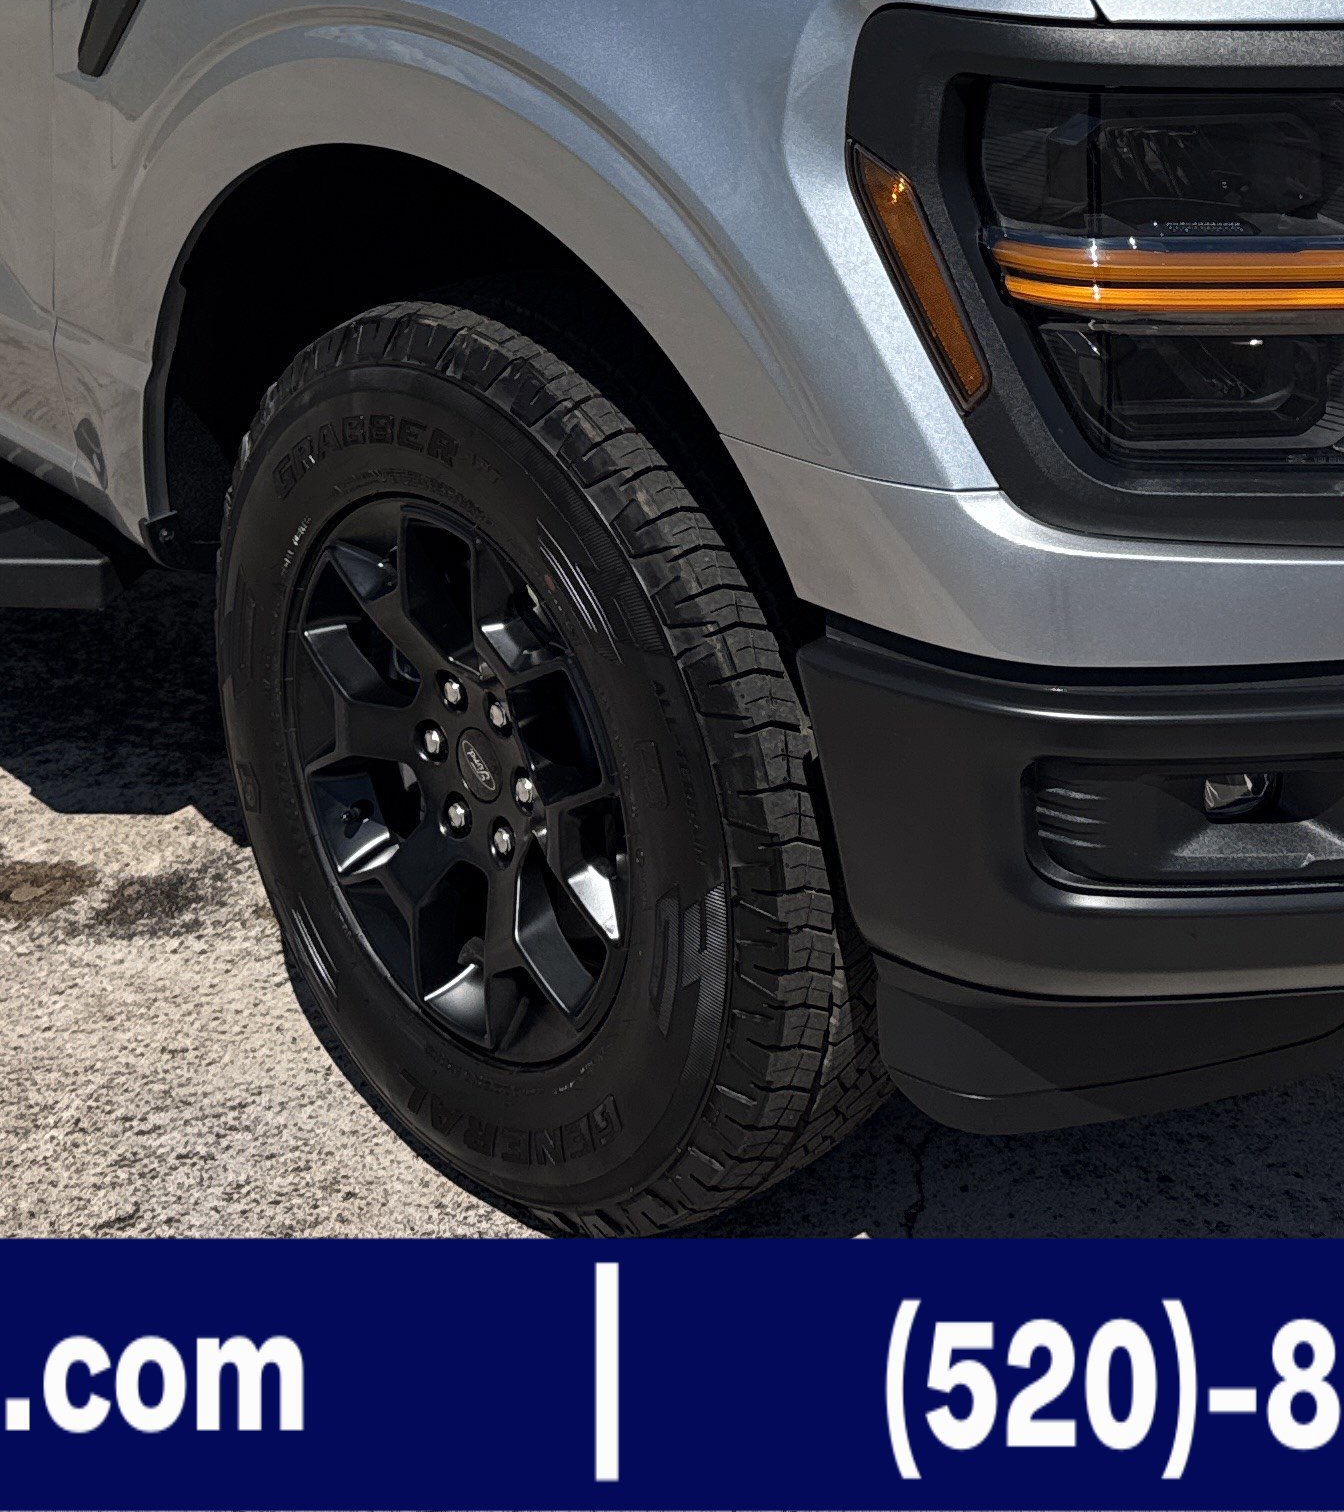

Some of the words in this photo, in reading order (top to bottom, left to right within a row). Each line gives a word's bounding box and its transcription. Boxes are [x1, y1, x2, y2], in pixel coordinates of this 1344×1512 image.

[273, 414, 460, 499] GRABBER
[467, 750, 490, 782] Ford
[396, 1066, 624, 1169] GENERAL
